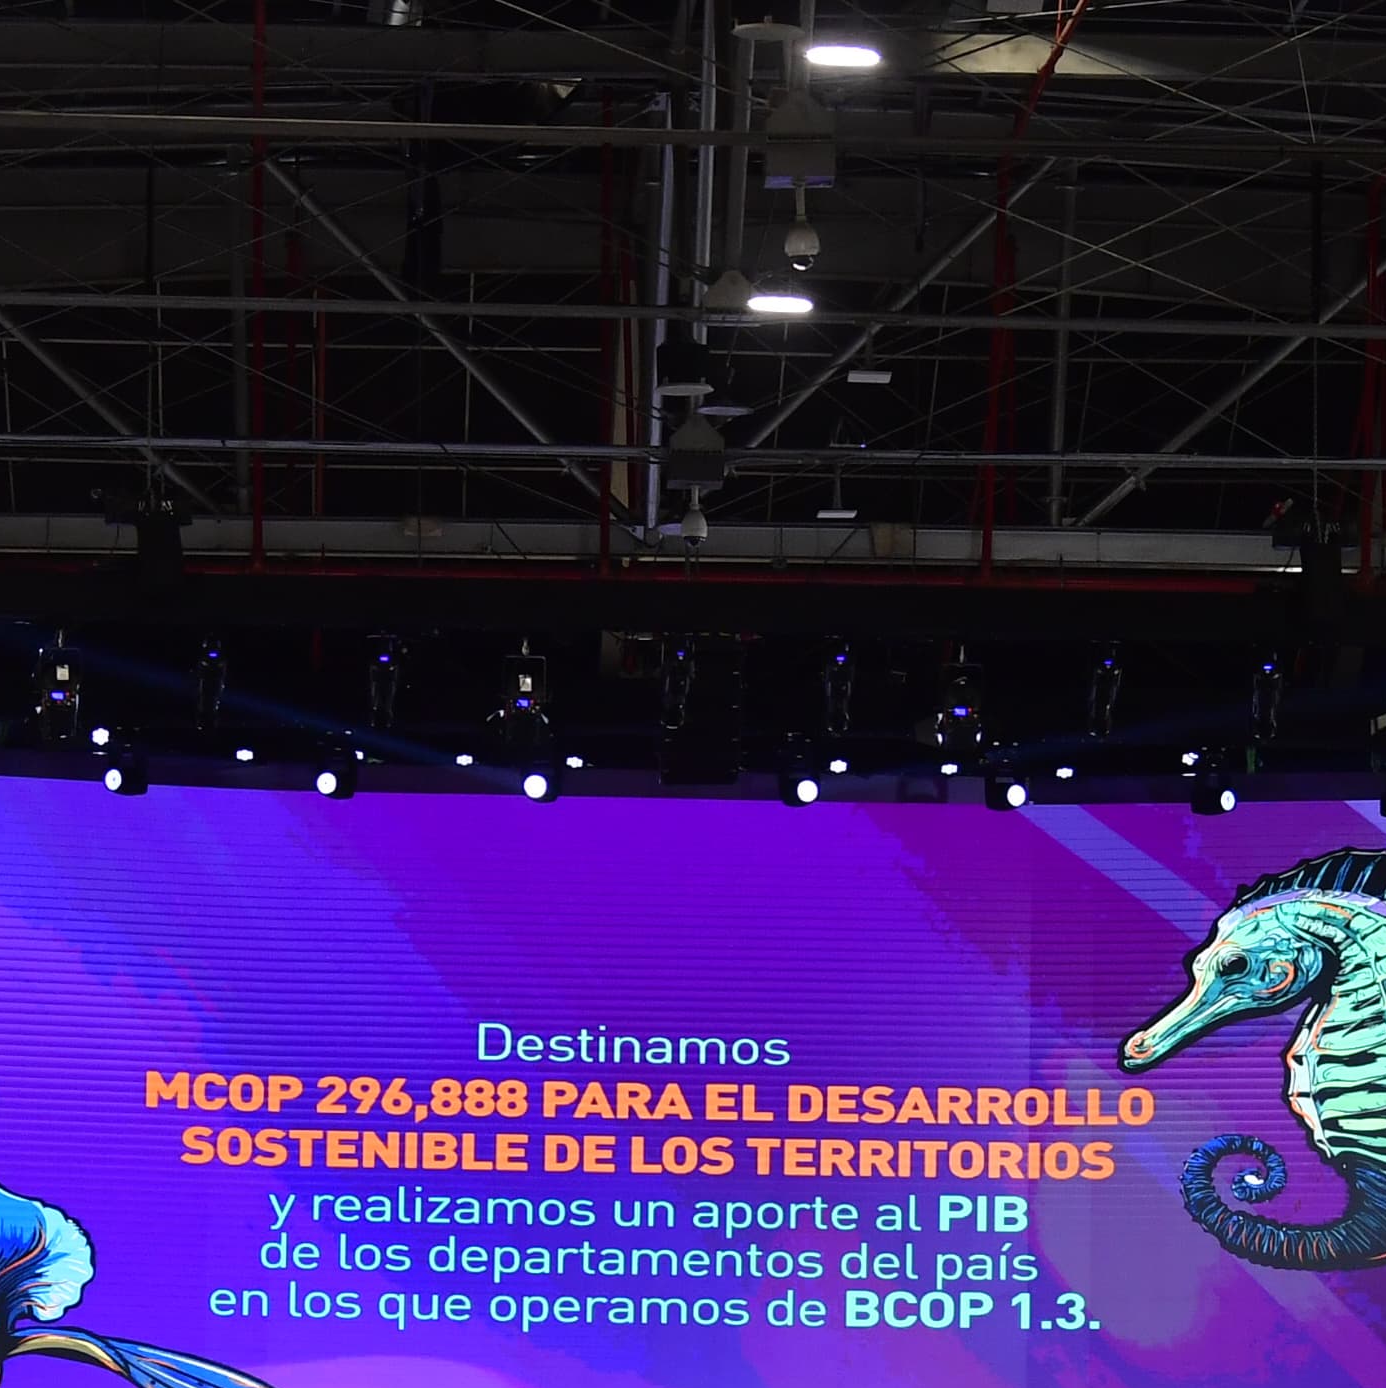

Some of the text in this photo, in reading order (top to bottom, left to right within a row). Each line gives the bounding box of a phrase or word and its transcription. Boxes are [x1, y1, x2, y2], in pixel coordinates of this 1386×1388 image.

[477, 1022, 791, 1066] Destinamos
[146, 1071, 1155, 1126] MCOP 296,888 PARA EL DESARROLLO
[180, 1126, 1115, 1180] SOSTENIBLE DE LOS TERRITORIOS
[268, 1185, 1029, 1239] y realizamos un aporte al PIB
[260, 1231, 1039, 1291] de los departamentos del país
[209, 1280, 1101, 1333] en los que operamos de BCOP 1.3.
